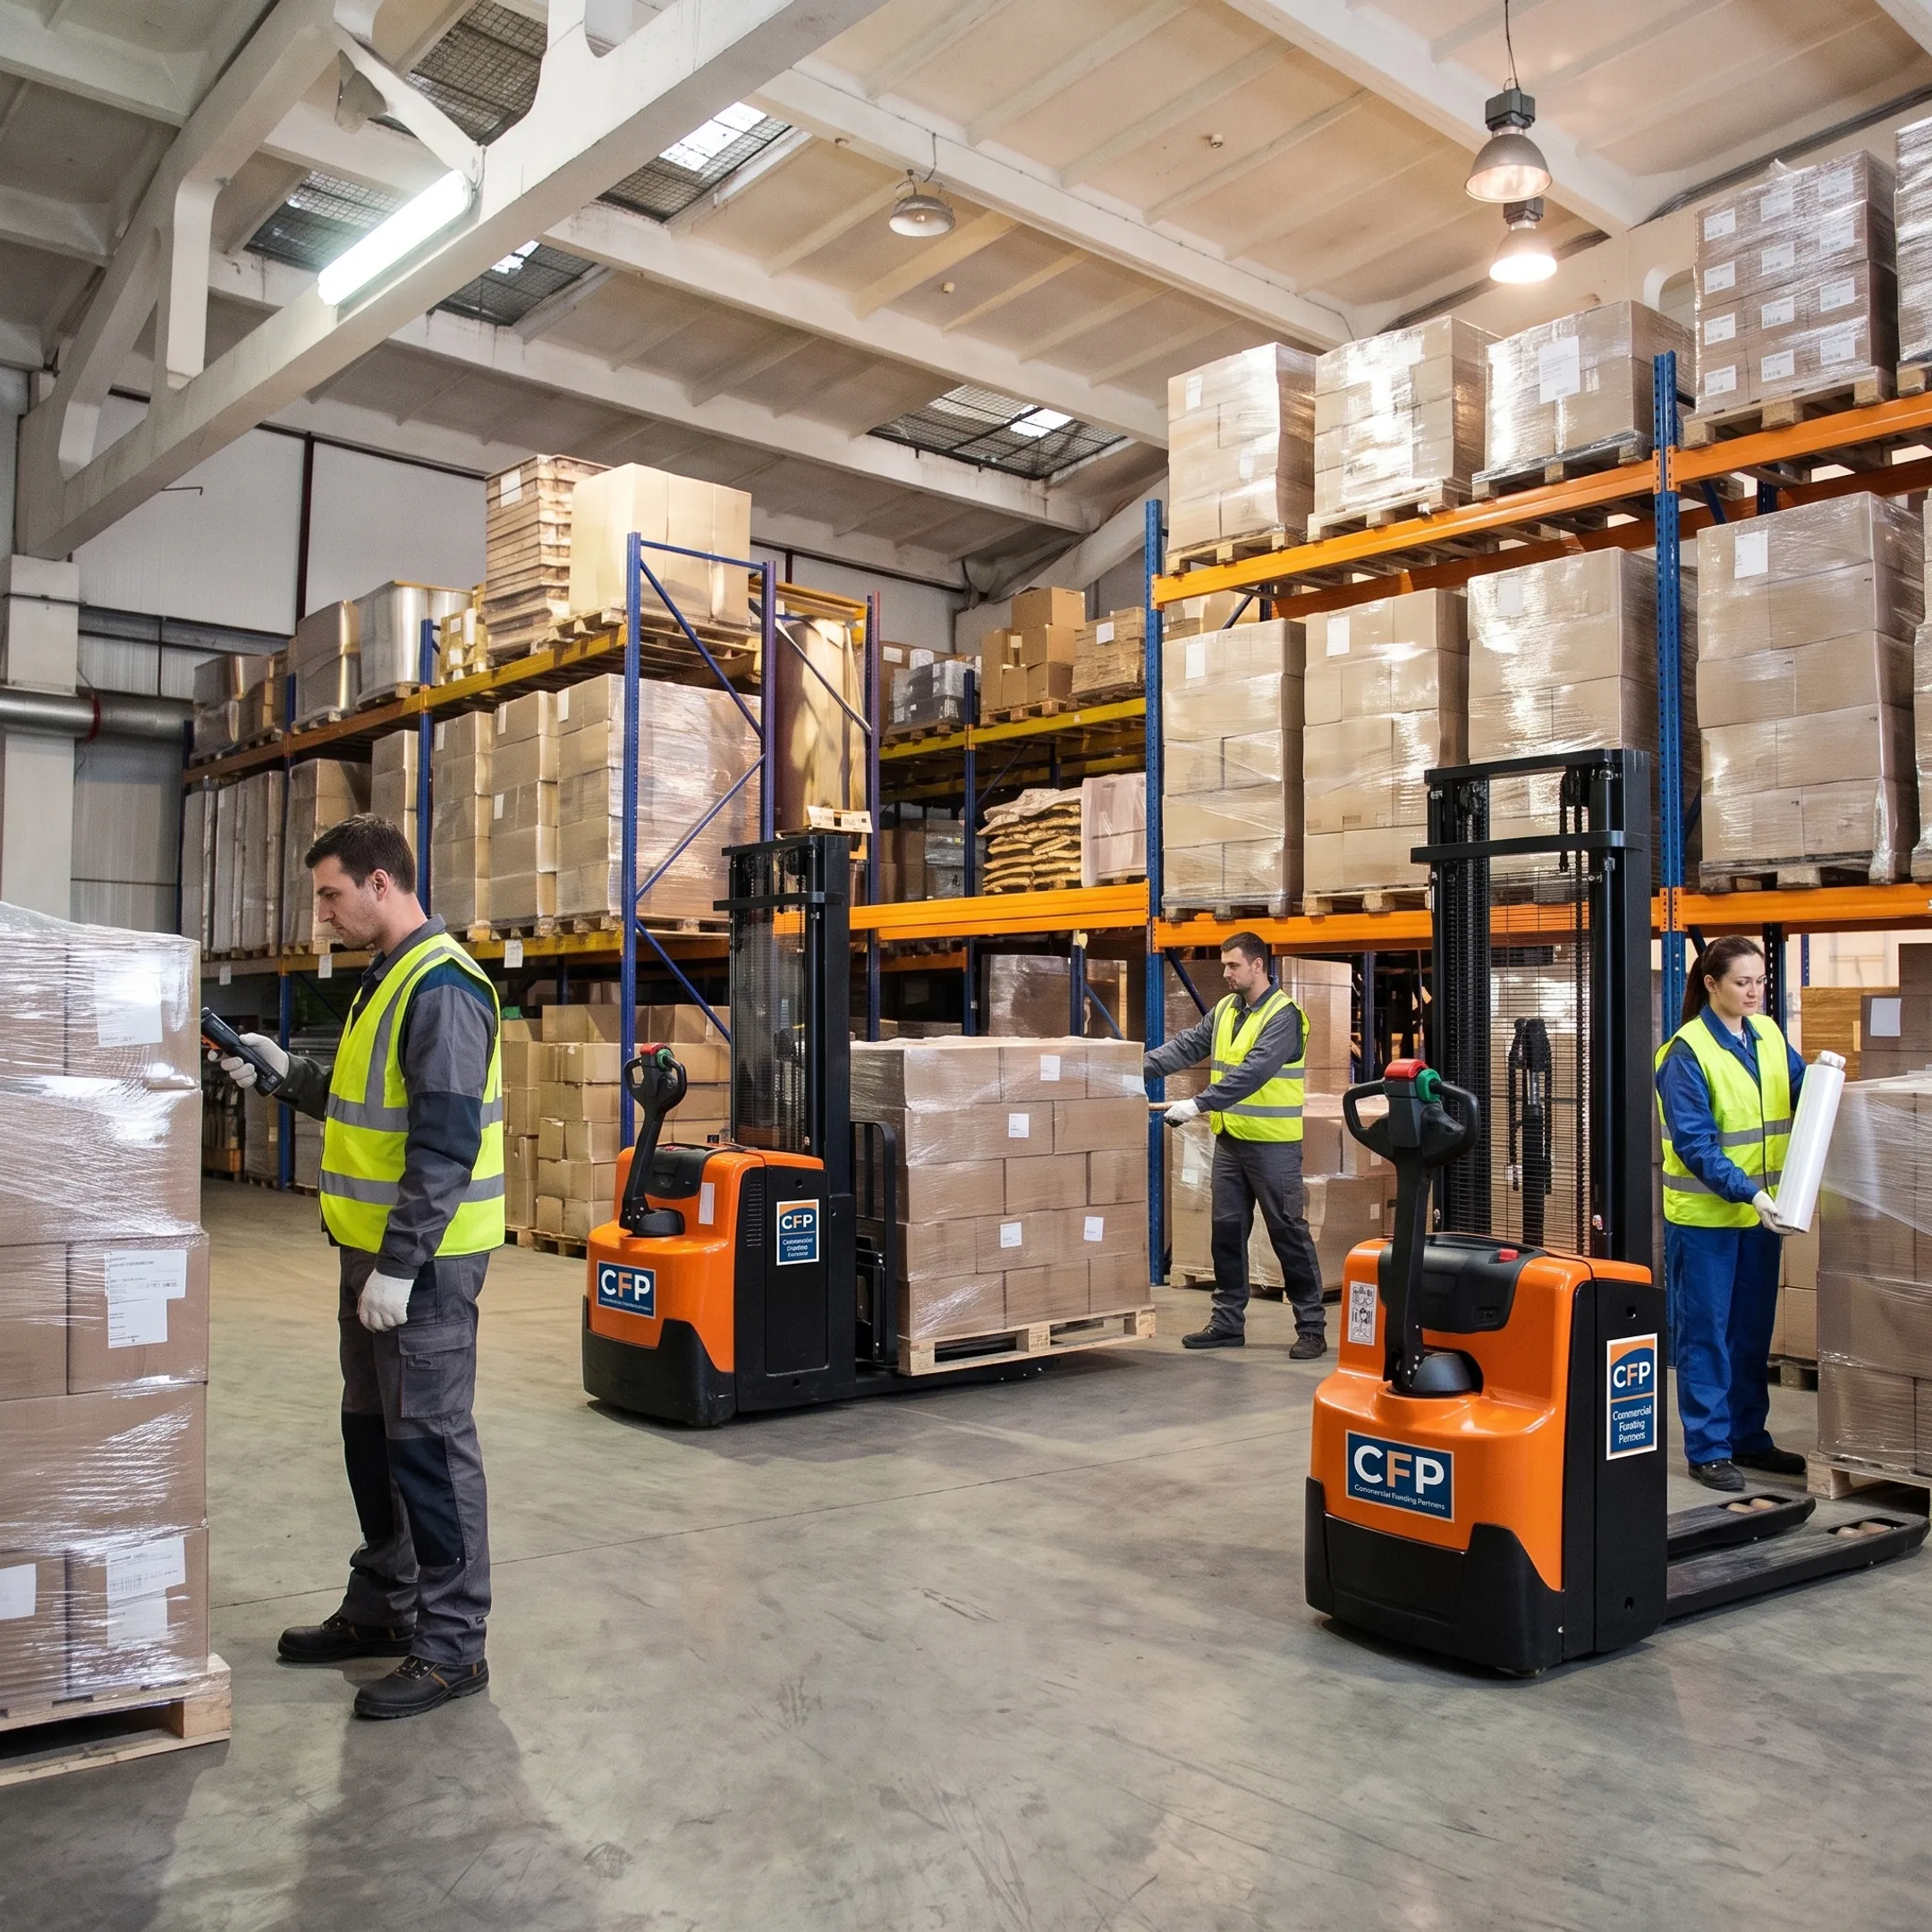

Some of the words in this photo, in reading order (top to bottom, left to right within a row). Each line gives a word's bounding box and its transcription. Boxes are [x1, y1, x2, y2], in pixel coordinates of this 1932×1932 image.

[782, 1215, 813, 1229] CFP
[601, 1269, 650, 1301] CFP
[1613, 1360, 1651, 1388] CFP
[1354, 1445, 1445, 1494] CFP
